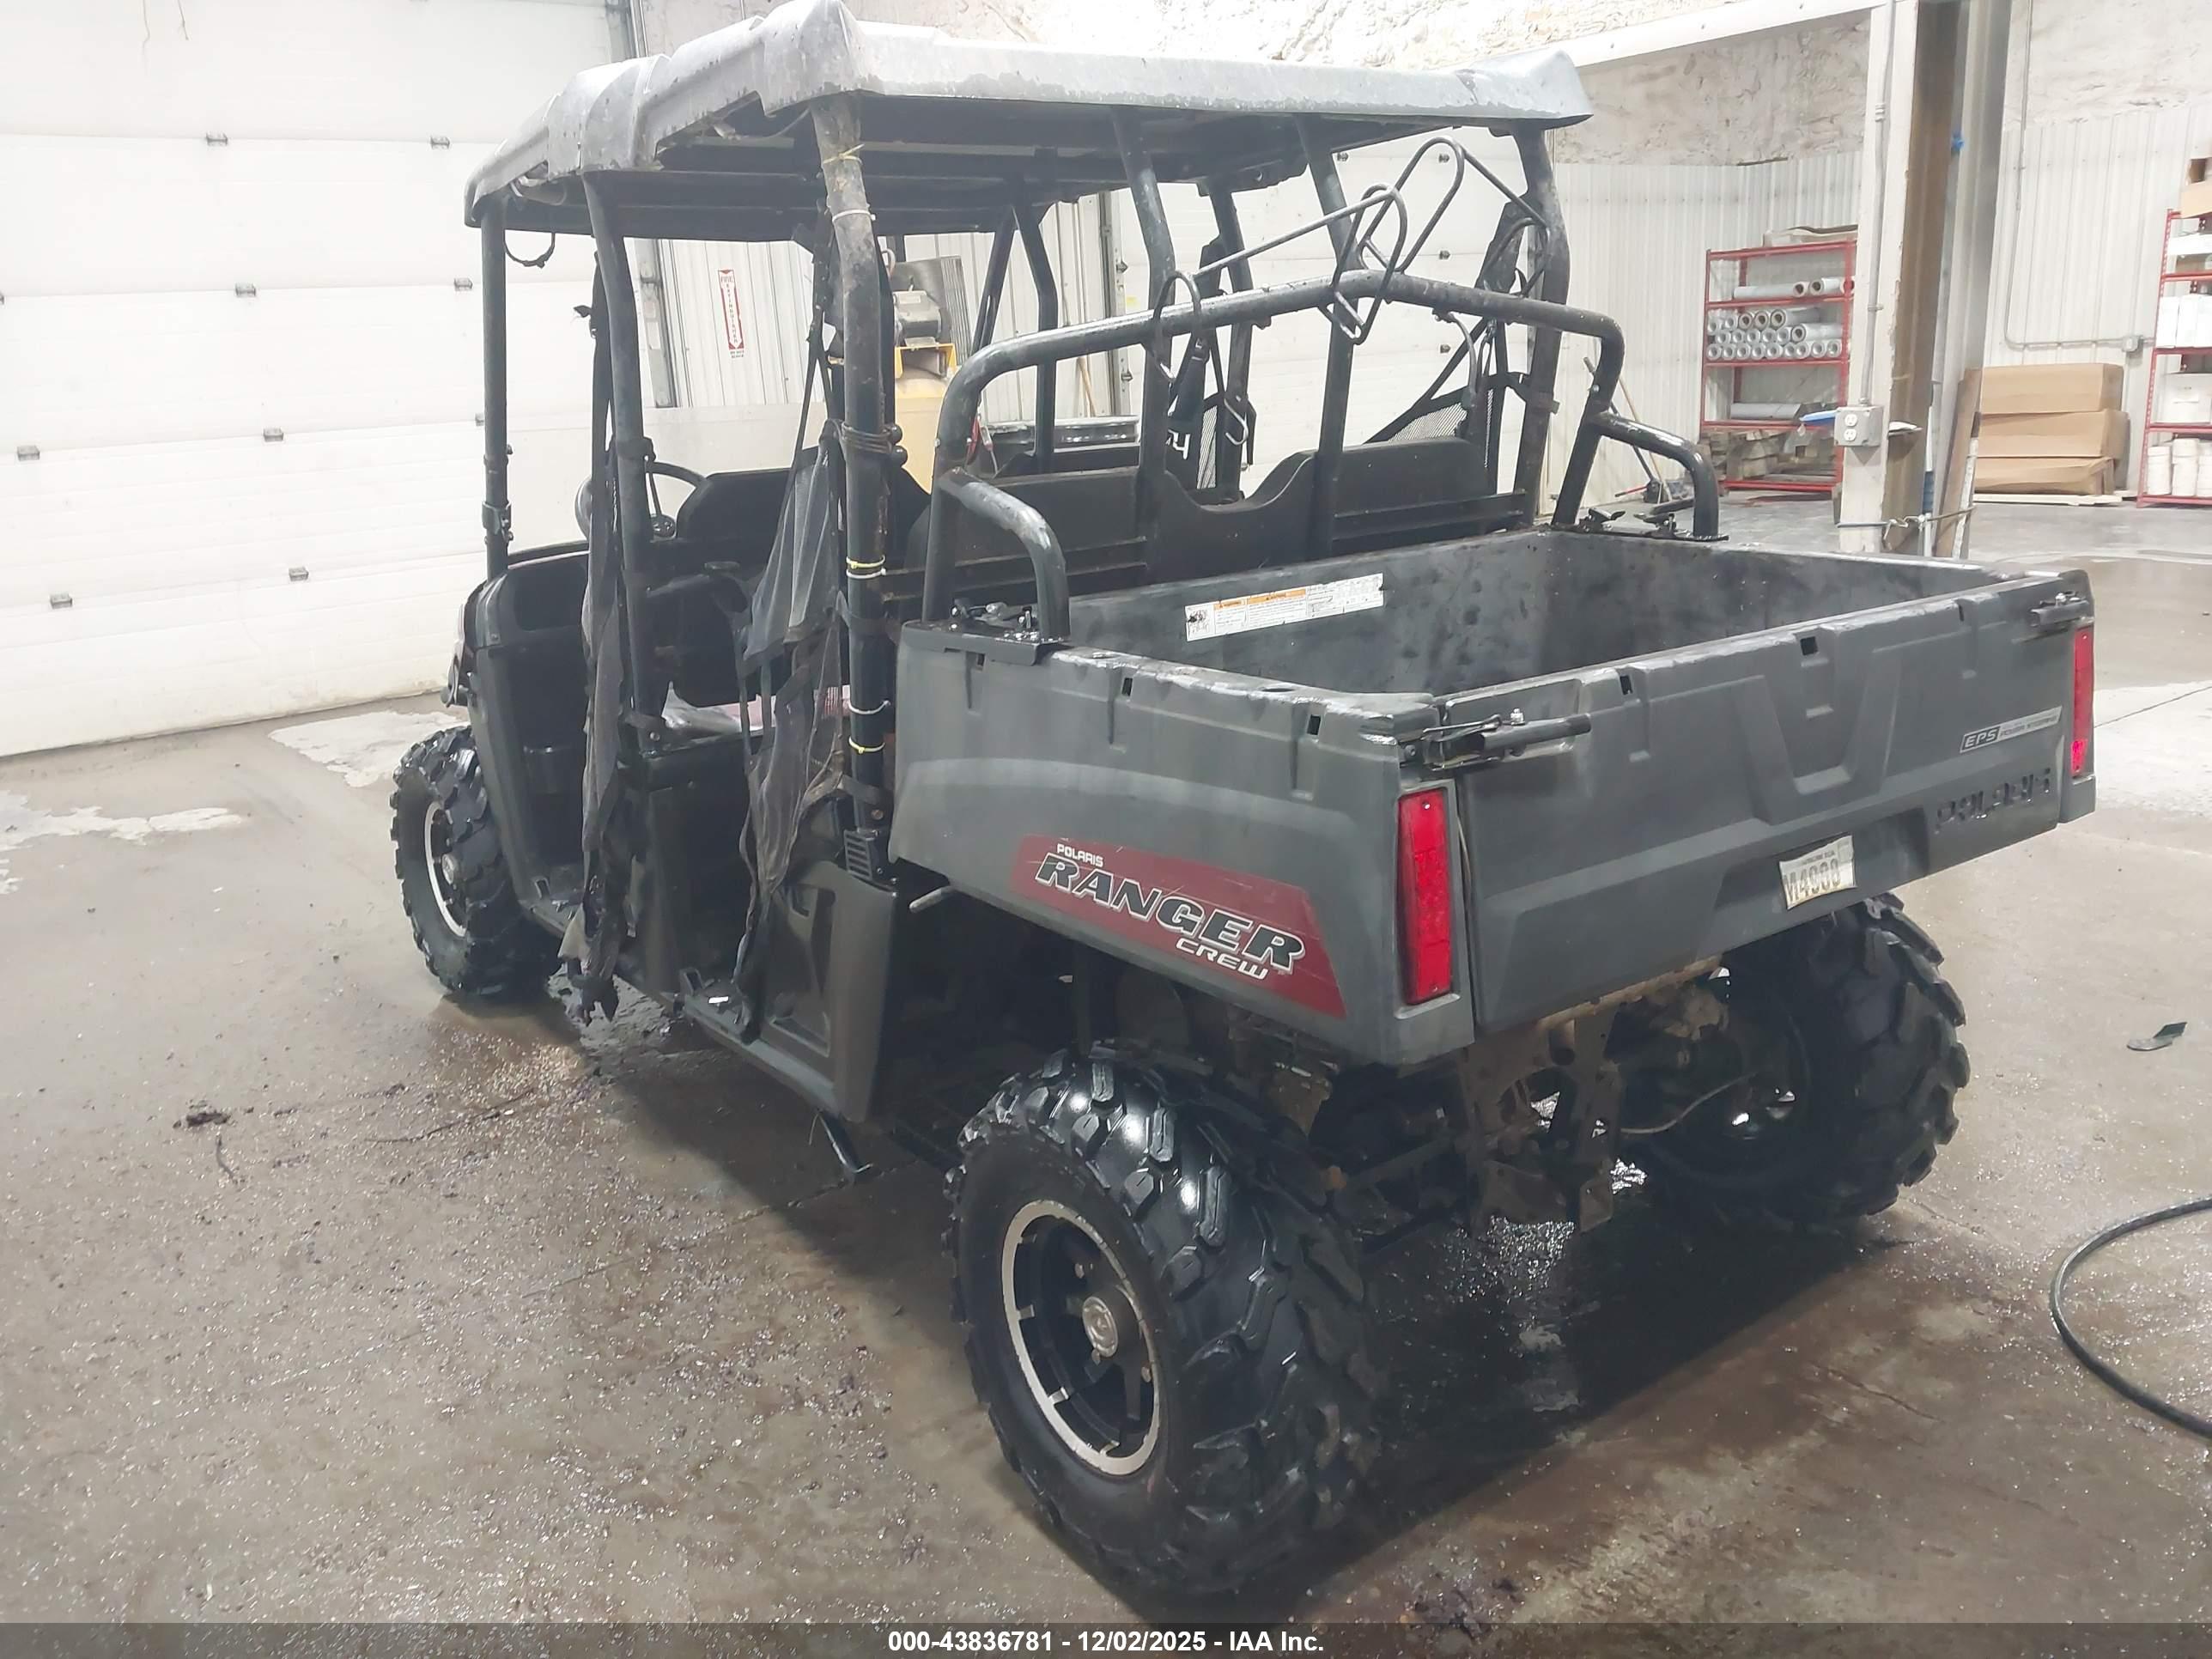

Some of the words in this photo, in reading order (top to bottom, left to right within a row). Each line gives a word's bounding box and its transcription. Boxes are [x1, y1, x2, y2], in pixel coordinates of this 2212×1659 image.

[1964, 728, 1998, 748] EPS
[1056, 843, 1104, 867] POLARIS
[1035, 853, 1305, 975] RANGER
[1176, 938, 1268, 980] CREW
